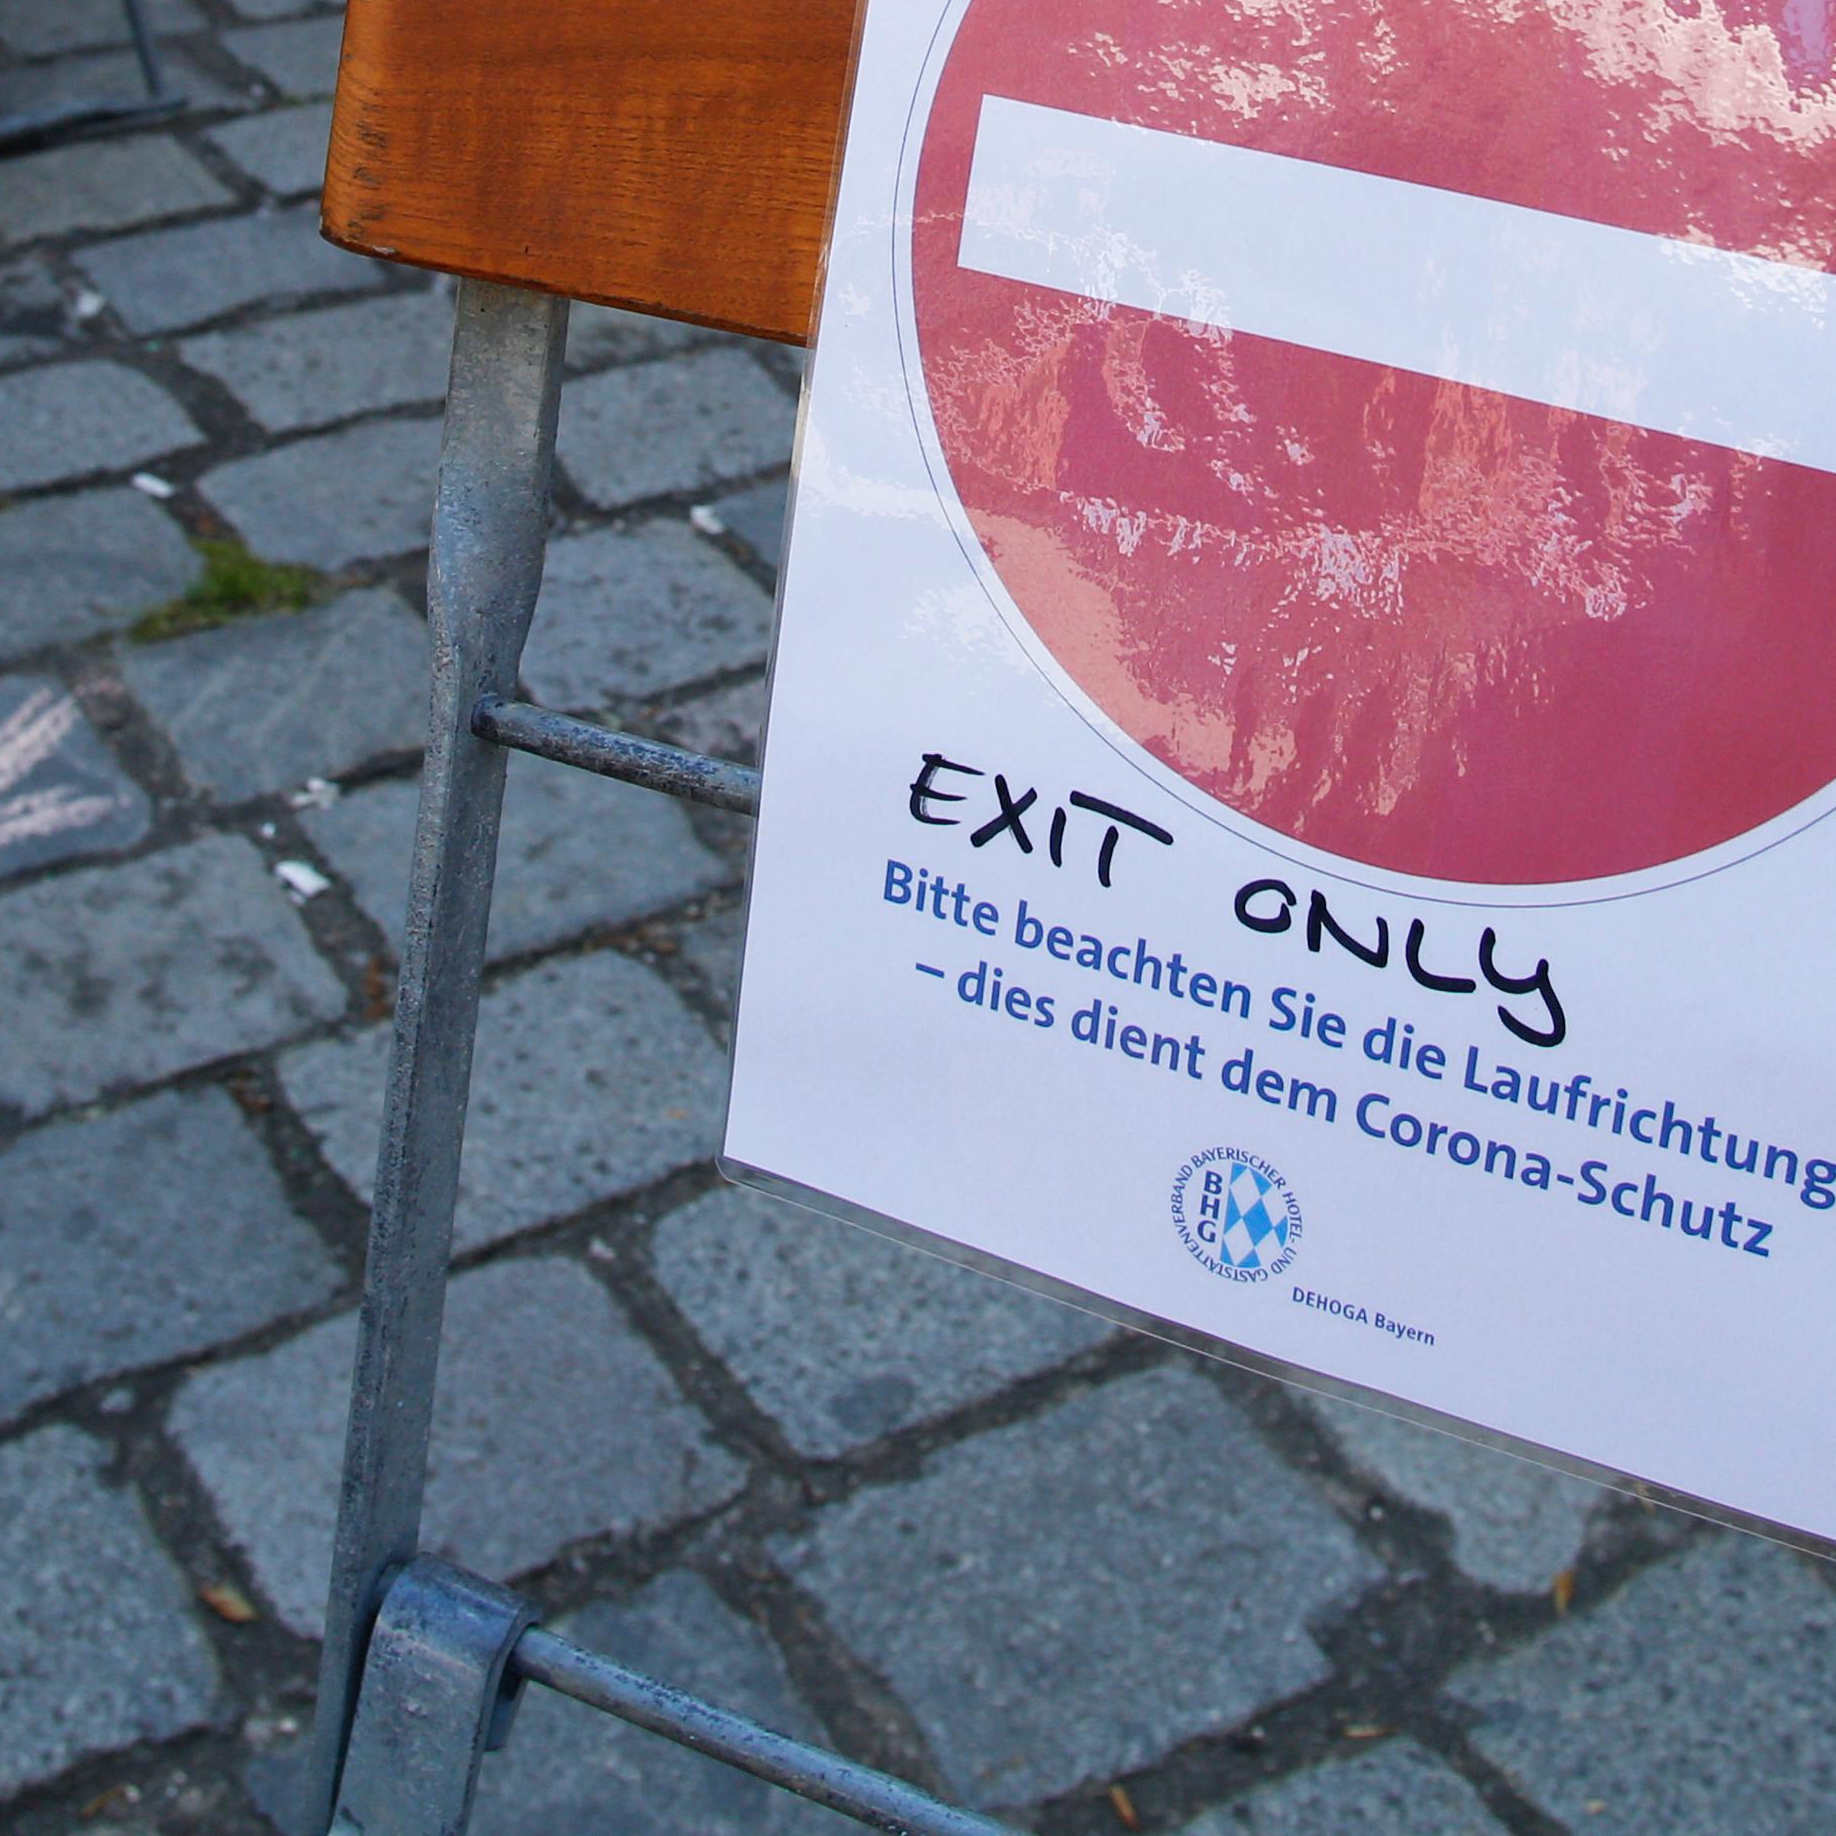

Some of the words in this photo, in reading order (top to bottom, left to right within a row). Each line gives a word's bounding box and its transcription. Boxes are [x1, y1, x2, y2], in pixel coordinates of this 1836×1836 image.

[909, 753, 1174, 888] EXIT
[1234, 878, 1566, 1049] ONLY
[883, 859, 999, 937] Bitte
[1014, 899, 1252, 1020] beachten
[1268, 987, 1347, 1049] Sie
[1362, 1016, 1447, 1081] die
[957, 960, 1055, 1029] dies
[1071, 998, 1206, 1080] dient
[1221, 1048, 1338, 1124] dem
[1355, 1093, 1774, 1259] Corona-Schutz
[1190, 1146, 1286, 1190] BAYERISCHER
[1282, 1190, 1303, 1244] HOTEL-
[1270, 1246, 1297, 1275] UND
[1292, 1286, 1368, 1325] DEHOGA
[1374, 1312, 1435, 1346] Bayern
